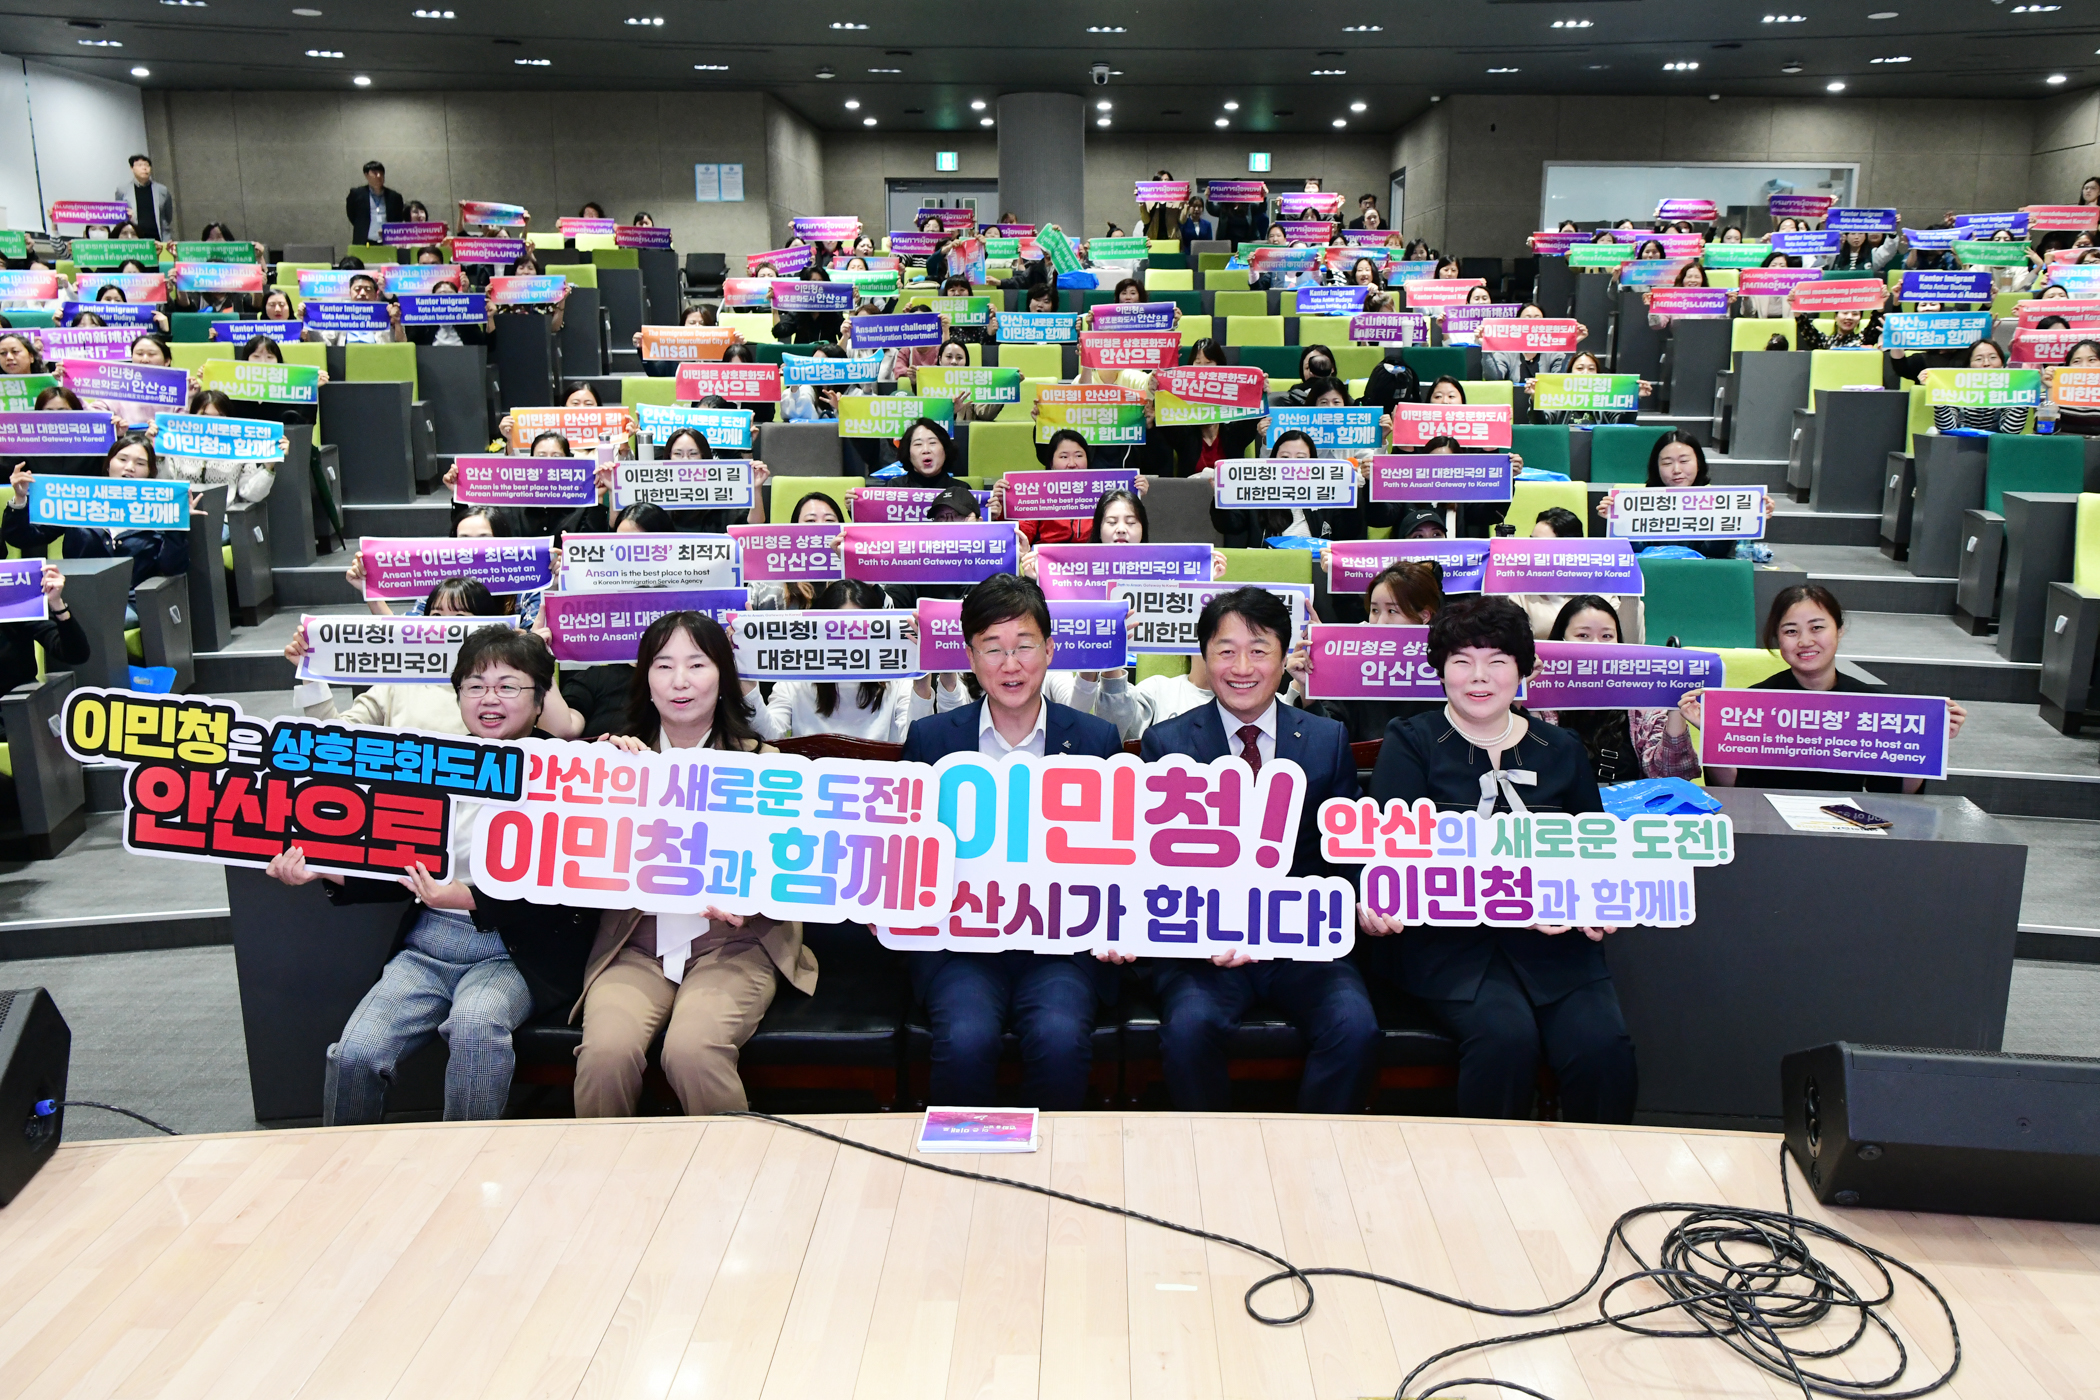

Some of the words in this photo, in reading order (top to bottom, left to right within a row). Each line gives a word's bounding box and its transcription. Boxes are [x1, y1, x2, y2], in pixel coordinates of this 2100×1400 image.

[1918, 274, 1940, 282] Kantor
[1942, 274, 1976, 283] Imigrant
[416, 297, 439, 306] Kantor
[440, 297, 470, 307] Imigrant
[1964, 290, 1988, 299] Ansan
[404, 313, 435, 322] diharapkan
[456, 313, 462, 321] di
[463, 312, 484, 321] Ansan
[660, 330, 696, 338] Immigration
[696, 330, 728, 338] Department
[856, 325, 882, 334] Ansan's
[884, 324, 900, 332] new
[901, 322, 938, 332] challenge!
[1002, 326, 1044, 340] 이민청과
[1046, 326, 1071, 340] 함께!
[1484, 324, 1529, 338] 이민청은
[1531, 324, 1576, 334] 상호문화도시
[710, 338, 720, 346] City
[856, 334, 868, 342] The
[870, 332, 902, 342] Immigration
[902, 332, 938, 340] Department!
[1526, 333, 1567, 347] 안산으로
[650, 343, 698, 358] Ansan
[99, 365, 142, 381] 이민청은
[235, 365, 288, 383] 이민청!
[682, 370, 719, 380] 이민청은
[721, 370, 774, 381] 상호문화도시
[1955, 372, 2009, 388] 이민청!
[73, 377, 129, 391] 상호문화도시
[132, 380, 177, 396] 안산으로
[698, 381, 760, 397] 안산으로
[1932, 388, 1987, 404] 안산시가
[1988, 389, 2037, 403] 합니다!
[466, 468, 493, 481] 안산
[547, 468, 586, 482] 최적지
[624, 468, 673, 483] 이민청!
[678, 468, 722, 483] 안산의
[726, 467, 740, 482] 길
[1229, 466, 1277, 480] 이민청!
[1280, 466, 1325, 481] 안산의
[1328, 466, 1342, 480] 길
[1381, 468, 1414, 479] 안산의
[1416, 468, 1430, 479] 길!
[1432, 467, 1487, 479] 대한민국의
[1489, 467, 1503, 478] 길!
[45, 483, 90, 498] 안산의
[93, 485, 137, 500] 새로운
[140, 487, 174, 500] 도전!
[1435, 480, 1467, 489] Gateway
[1476, 480, 1499, 488] Korea!
[634, 487, 706, 502] 대한민국의
[712, 487, 733, 502] 길!
[1236, 486, 1310, 501] 대한민국의
[1316, 486, 1335, 501] 길!
[1623, 495, 1677, 512] 이민청!
[1681, 494, 1732, 511] 안산의
[1736, 494, 1752, 510] 길
[39, 499, 125, 522] 이민청과
[127, 503, 180, 524] 함께!
[1632, 516, 1715, 534] 대한민국의
[1720, 516, 1742, 532] 길!
[568, 545, 605, 563] 안산
[678, 544, 731, 561] 최적지
[854, 540, 895, 554] 안산의
[898, 540, 915, 553] 길!
[918, 540, 986, 554] 대한민국의
[989, 540, 1006, 553] 길!
[858, 558, 878, 566] Path
[880, 558, 889, 566] to
[891, 557, 921, 566] Ansan!
[923, 557, 962, 567] Gateway
[974, 557, 1003, 566] Korea!
[1492, 554, 1530, 567] 안산의
[1533, 553, 1550, 567] 길!
[1553, 553, 1615, 567] 대한민국의
[1617, 553, 1635, 567] 길!
[585, 568, 619, 578] Ansan
[621, 569, 627, 577] is
[628, 569, 641, 577] the
[642, 569, 659, 577] best
[661, 569, 682, 578] place
[683, 568, 692, 576] to
[693, 568, 710, 576] host
[1496, 569, 1514, 578] Path
[1526, 569, 1554, 578] Ansan!
[1556, 570, 1593, 579] Gateway
[1604, 570, 1631, 578] Korea!
[621, 578, 656, 587] Immigration
[680, 578, 703, 586] Agency
[743, 621, 817, 640] 이민청!
[824, 620, 891, 640] 안산의
[757, 648, 876, 671] 대한민국의
[879, 648, 908, 670] 길!
[1720, 707, 1765, 728] 안산
[1857, 712, 1926, 736] 최적지
[72, 699, 263, 764] 이민청은
[272, 728, 518, 795] 상호문화도시
[1724, 732, 1761, 742] Ansan
[1763, 733, 1772, 743] is
[1774, 734, 1794, 744] the
[1796, 735, 1822, 745] best
[1825, 736, 1858, 749] place
[1860, 737, 1873, 748] to
[1875, 738, 1901, 749] host
[1903, 741, 1920, 750] an
[1718, 743, 1758, 754] Korean
[1760, 744, 1831, 758] Immigration
[1832, 746, 1879, 759] Service
[1881, 750, 1926, 764] Agency
[528, 754, 649, 808] 안산의
[659, 763, 803, 817] 새로운
[814, 774, 924, 825] 도전!
[135, 766, 445, 873] 안산으로
[938, 763, 1294, 869] 이민청!
[1324, 803, 1477, 858] 안산의
[1491, 817, 1617, 859] 새로운
[1632, 818, 1729, 861] 도전!
[485, 810, 757, 898] 이민청과
[768, 825, 940, 912] 함께!
[1367, 864, 1581, 921] 이민청과
[1591, 878, 1690, 921] 함께!
[889, 879, 1126, 942] 산시가
[1143, 883, 1343, 947] 합니다!
